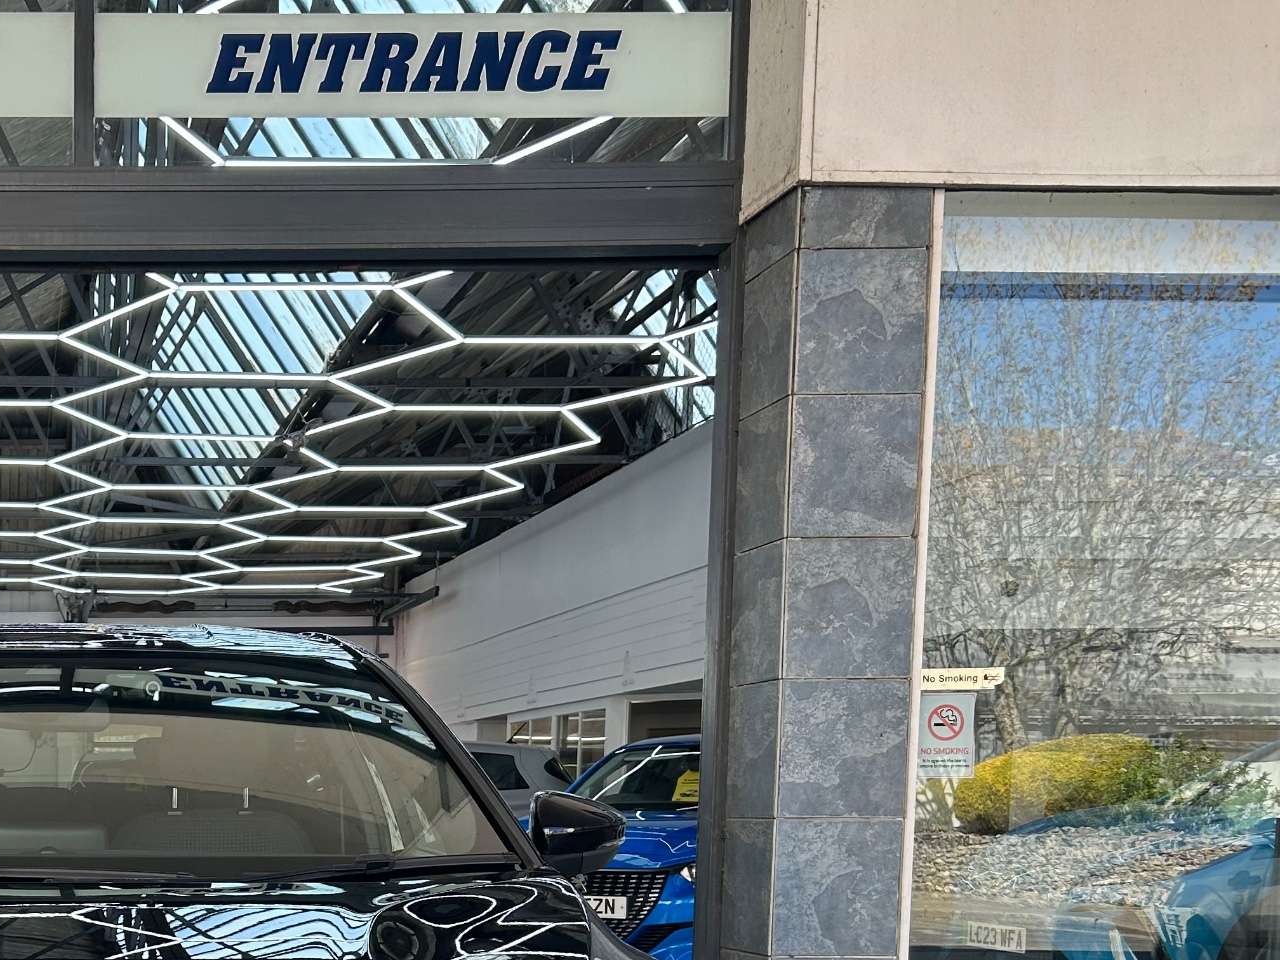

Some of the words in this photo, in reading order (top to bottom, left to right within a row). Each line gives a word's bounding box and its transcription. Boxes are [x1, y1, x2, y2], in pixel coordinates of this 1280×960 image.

[205, 29, 623, 94] ENTRANCE
[922, 675, 935, 683] No
[938, 674, 978, 684] Smoking
[587, 897, 615, 915] ZN
